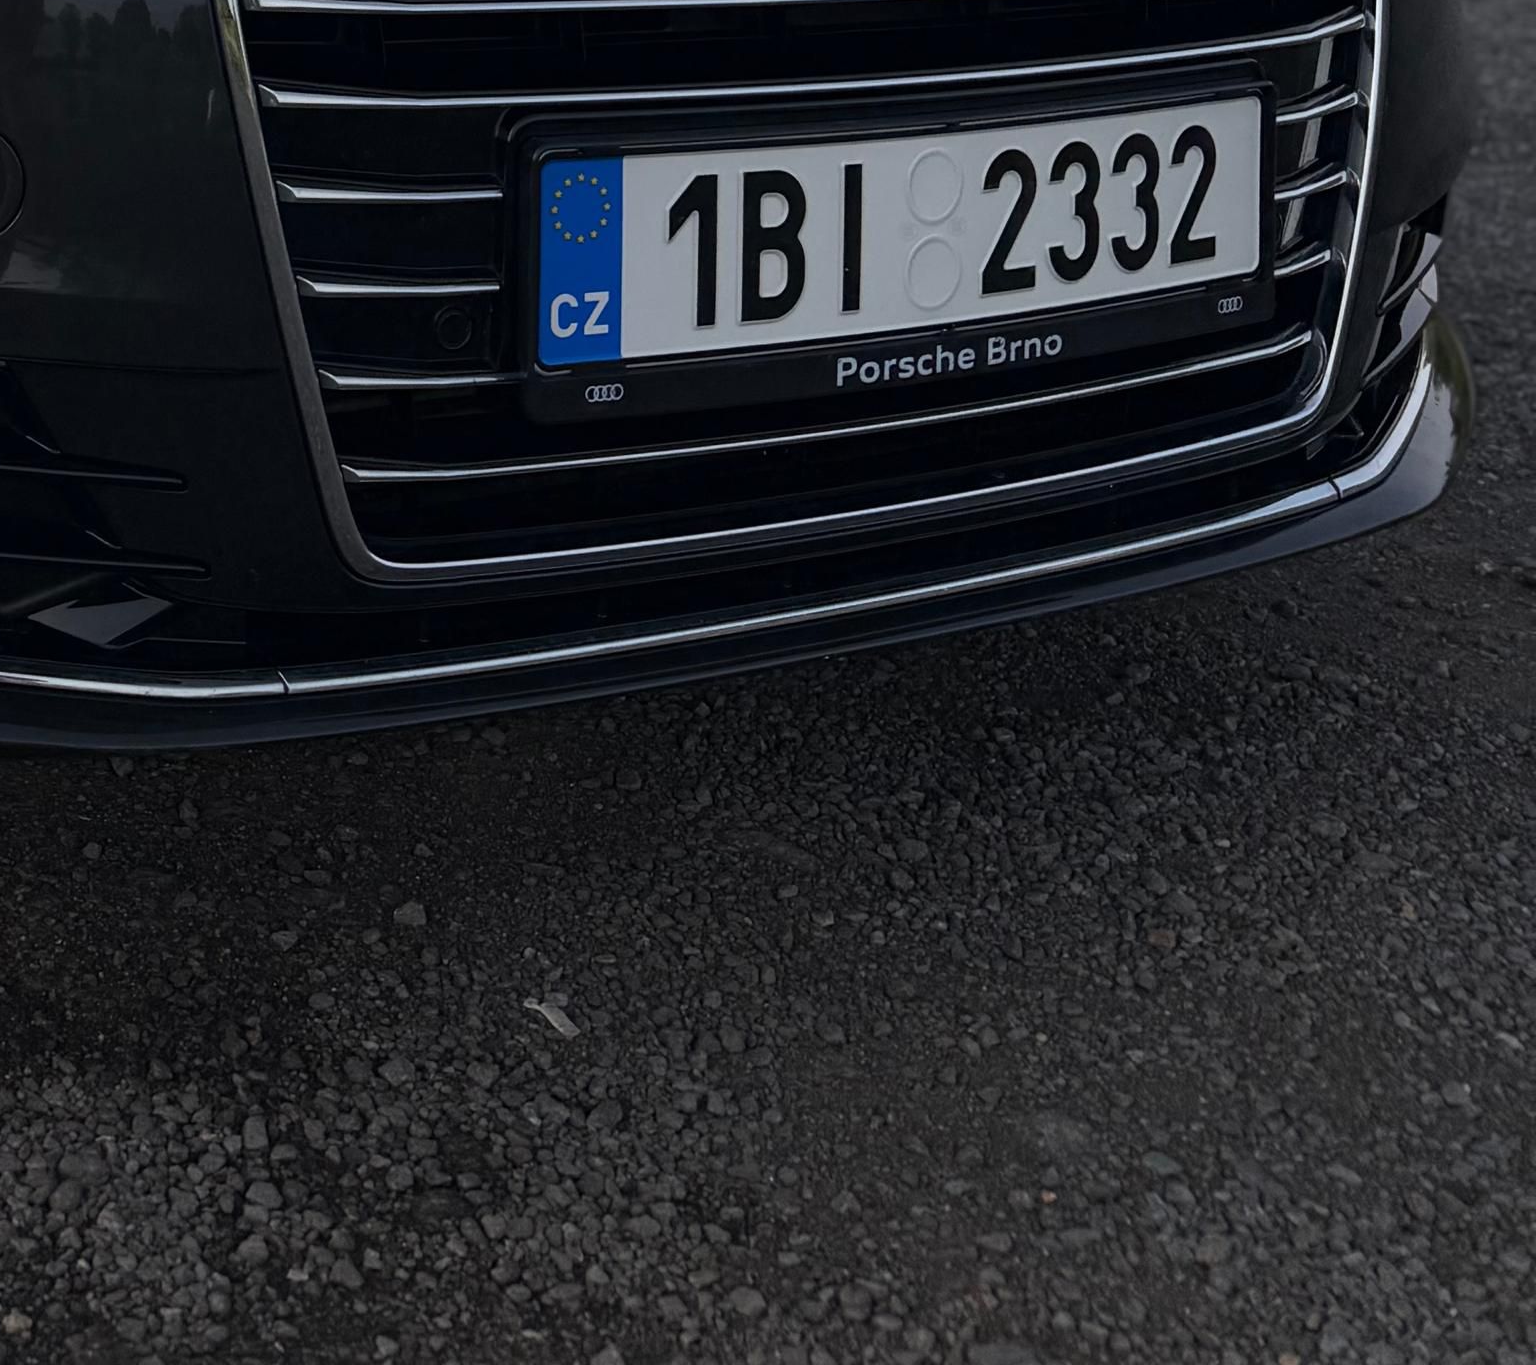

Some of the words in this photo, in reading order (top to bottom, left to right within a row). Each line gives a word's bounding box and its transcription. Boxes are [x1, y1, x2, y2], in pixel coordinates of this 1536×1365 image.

[667, 162, 863, 327] 1BI
[981, 124, 1217, 296] 2332
[550, 291, 611, 338] CZ
[835, 345, 976, 387] Porsche
[988, 334, 1064, 367] Brno
